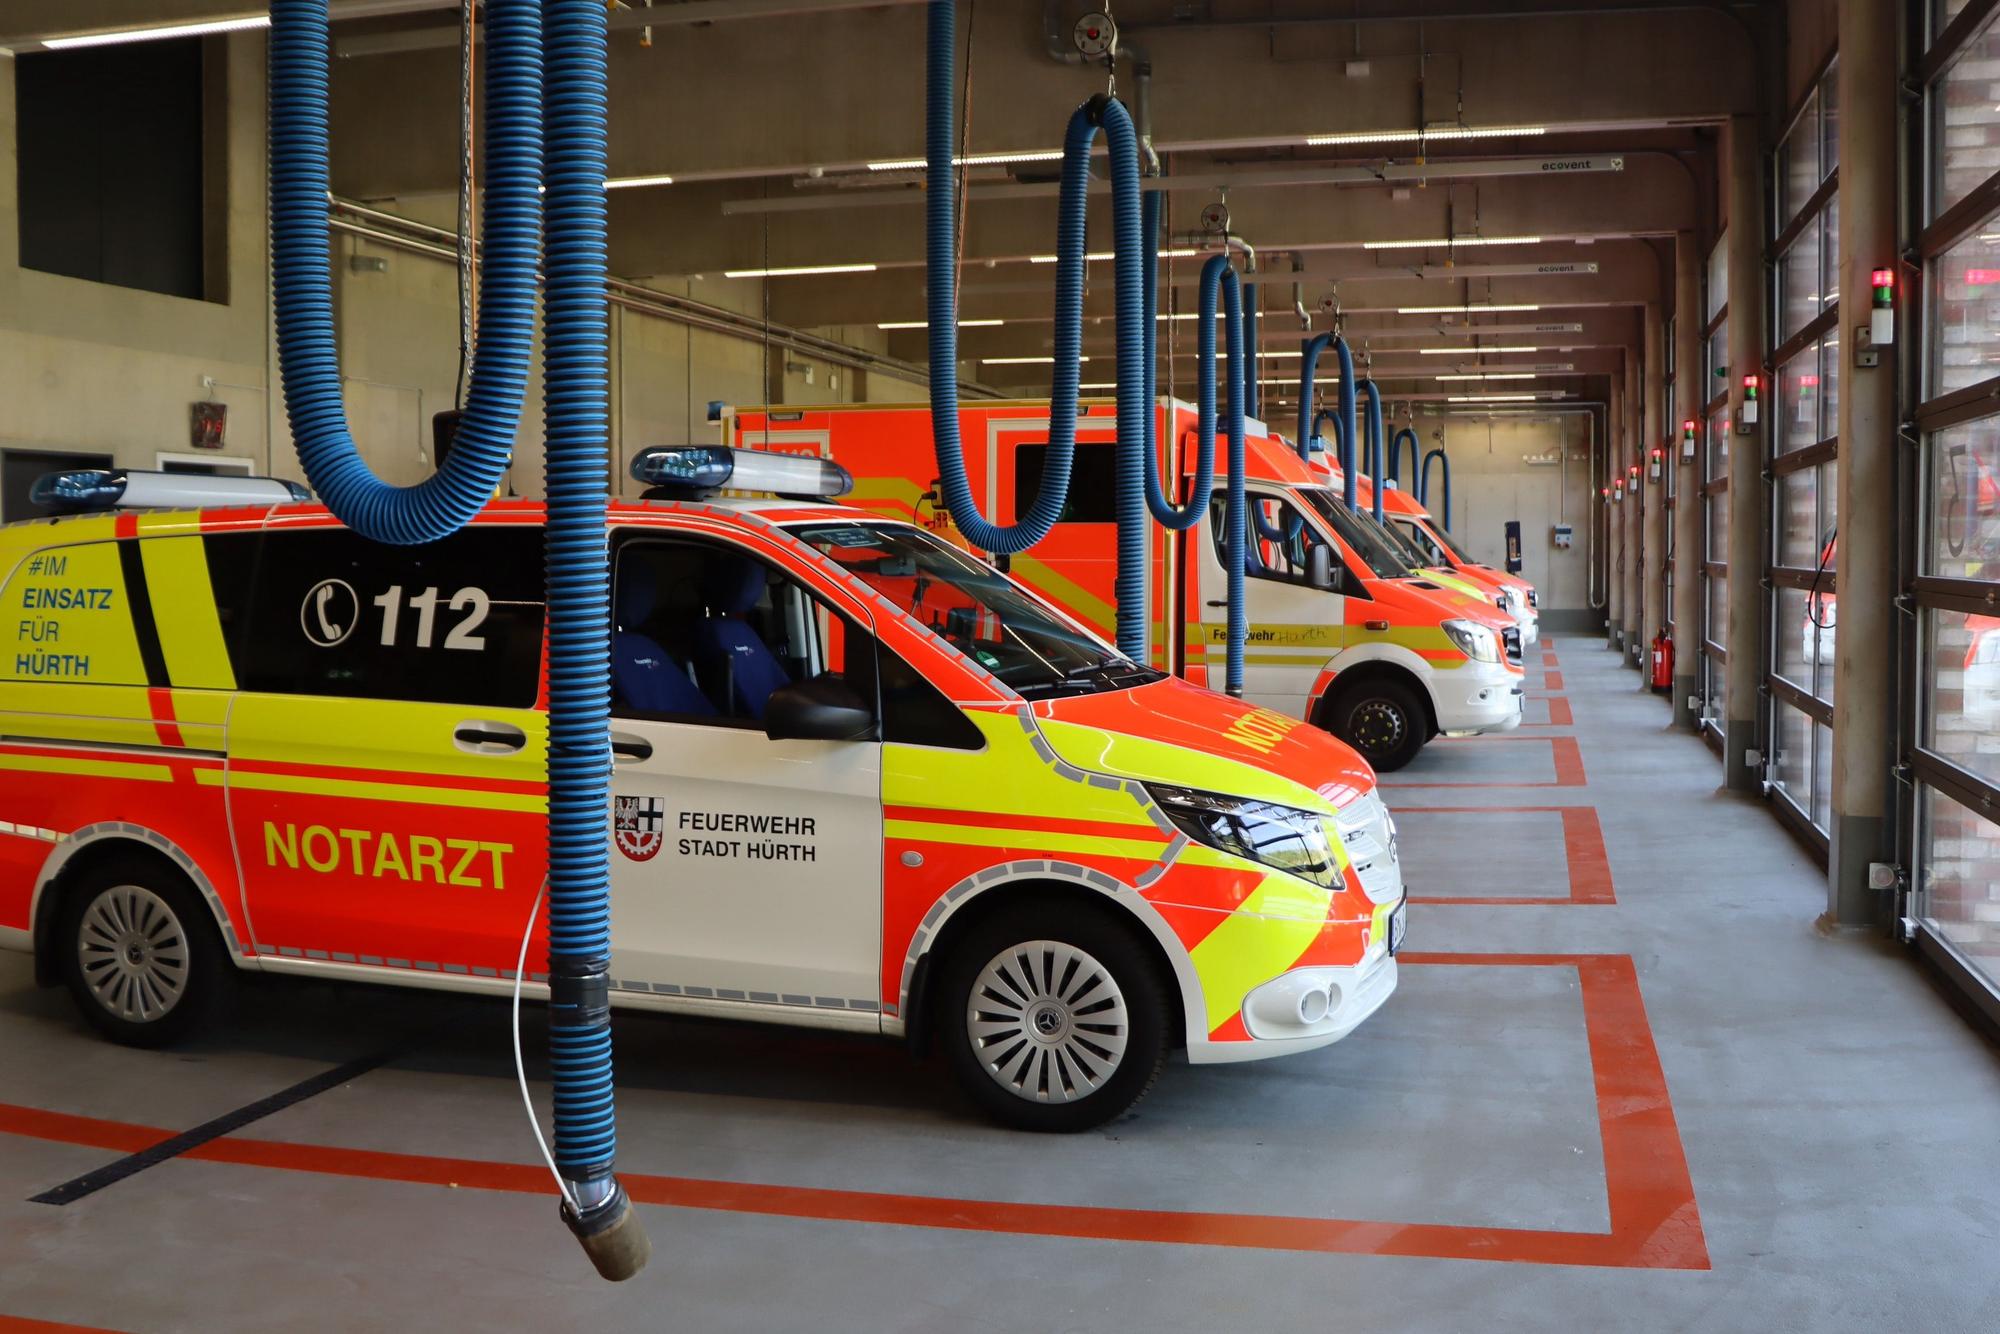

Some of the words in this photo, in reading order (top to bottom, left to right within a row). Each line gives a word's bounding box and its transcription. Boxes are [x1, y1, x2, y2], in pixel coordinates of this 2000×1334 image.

[1541, 160, 1592, 171] ecovent
[1538, 263, 1575, 273] ecovent
[28, 556, 67, 576] #IM
[22, 587, 113, 610] EINSATZ
[18, 615, 59, 642] FÜR
[373, 585, 490, 650] 112
[1213, 628, 1275, 641] Fewehr
[15, 648, 89, 676] HÜRTH
[679, 811, 816, 836] FEUERWEHR
[263, 821, 513, 890] NOTARZT
[678, 838, 741, 858] STADT
[748, 838, 816, 862] HÜRTH
